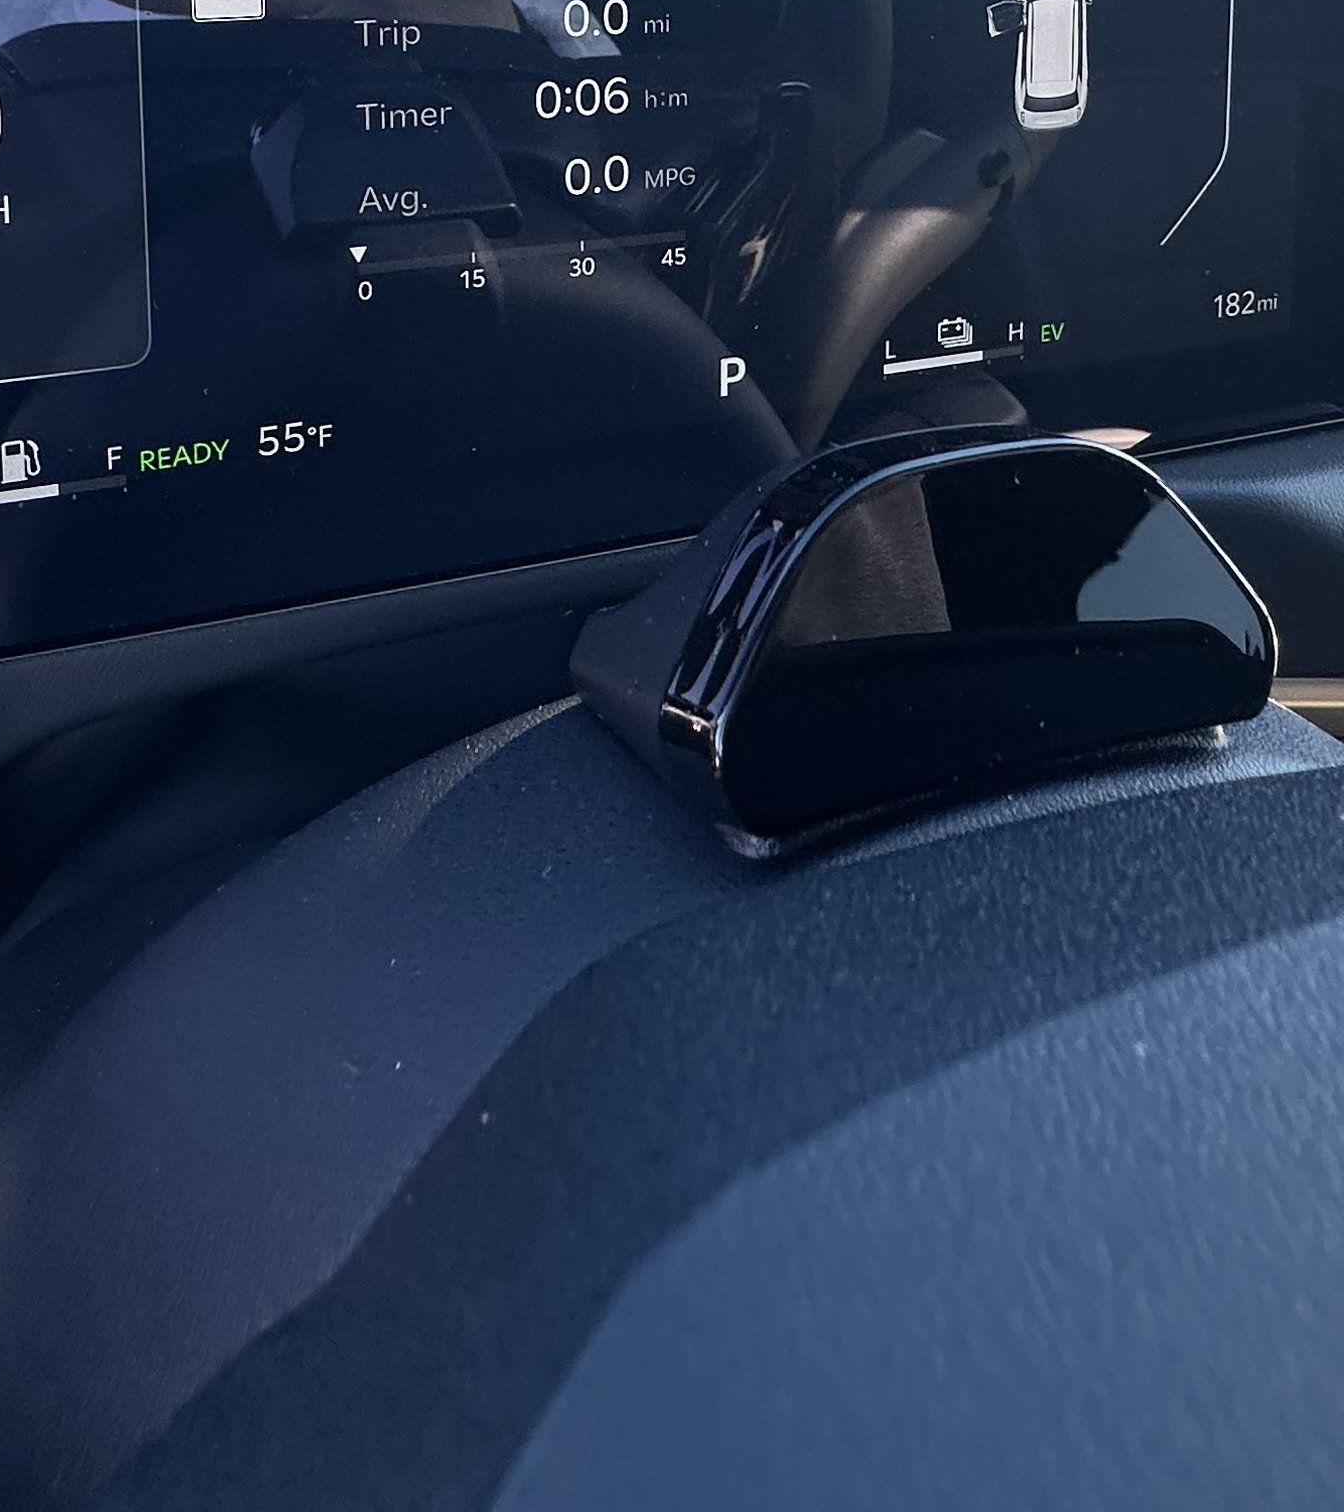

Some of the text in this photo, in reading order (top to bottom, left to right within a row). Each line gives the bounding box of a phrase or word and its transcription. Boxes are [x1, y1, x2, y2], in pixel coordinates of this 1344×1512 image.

[354, 19, 422, 52] Trip
[643, 13, 672, 34] mi
[357, 101, 453, 131] Timer
[535, 77, 630, 119] 0:06
[358, 155, 697, 219] Avg. 0.0 MPG
[357, 246, 687, 301] 0 15 30 45
[884, 321, 1065, 360] L H EV
[719, 356, 747, 398] P
[107, 445, 123, 471] F
[139, 420, 333, 472] READY 55°F
